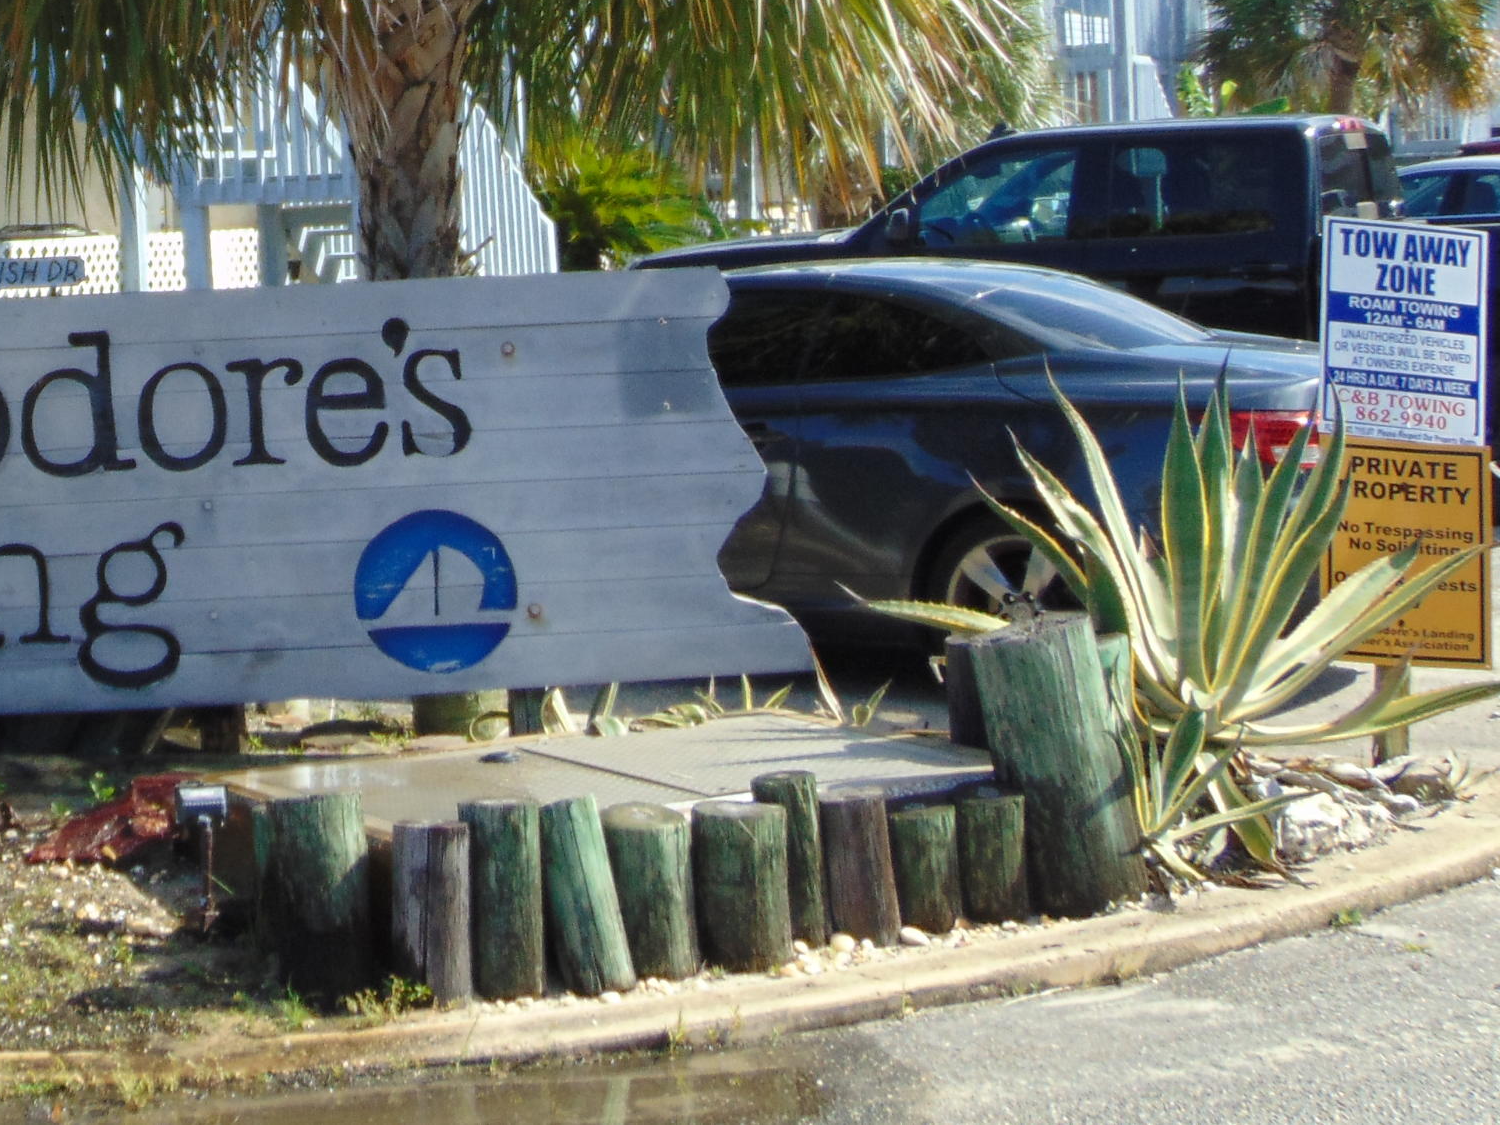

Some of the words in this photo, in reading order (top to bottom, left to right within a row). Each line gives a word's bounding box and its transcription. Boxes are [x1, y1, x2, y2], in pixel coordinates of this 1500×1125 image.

[1339, 228, 1397, 260] TOW
[1404, 234, 1472, 267] AWAY
[46, 259, 79, 283] DR
[1375, 263, 1436, 296] ZONE
[1349, 296, 1396, 313] ROAM
[1400, 300, 1461, 319] TOWING
[1365, 312, 1401, 326] 12AM
[1415, 316, 1445, 331] 6AM
[1341, 328, 1417, 345] UNAUTHORIZED
[1420, 335, 1466, 350] VEHICLES
[1334, 341, 1349, 352] OR
[1351, 342, 1395, 357] VESSELS
[1397, 347, 1421, 359] WILL
[1423, 349, 1436, 360] BE
[1438, 351, 1471, 364] TOWED
[1352, 356, 1365, 367] AT
[1411, 362, 1456, 376] EXPENSE
[1346, 371, 1367, 385] HRS
[1367, 374, 1378, 386] A
[1401, 376, 1408, 388] 7
[1408, 377, 1434, 391] DAYS
[1434, 379, 1444, 392] A
[1444, 381, 1471, 395] WEEK
[1337, 388, 1379, 406] C&B
[1388, 393, 1466, 417] TOWING
[1355, 406, 1447, 430] 862-9940
[1351, 456, 1458, 480] PRIVATE
[1339, 479, 1471, 505] ROPERTY
[1337, 520, 1360, 533] No
[1364, 522, 1474, 544] Trespassing
[1349, 537, 1372, 551] No
[1394, 638, 1469, 652] Assciation
[1422, 629, 1475, 642] Landing
